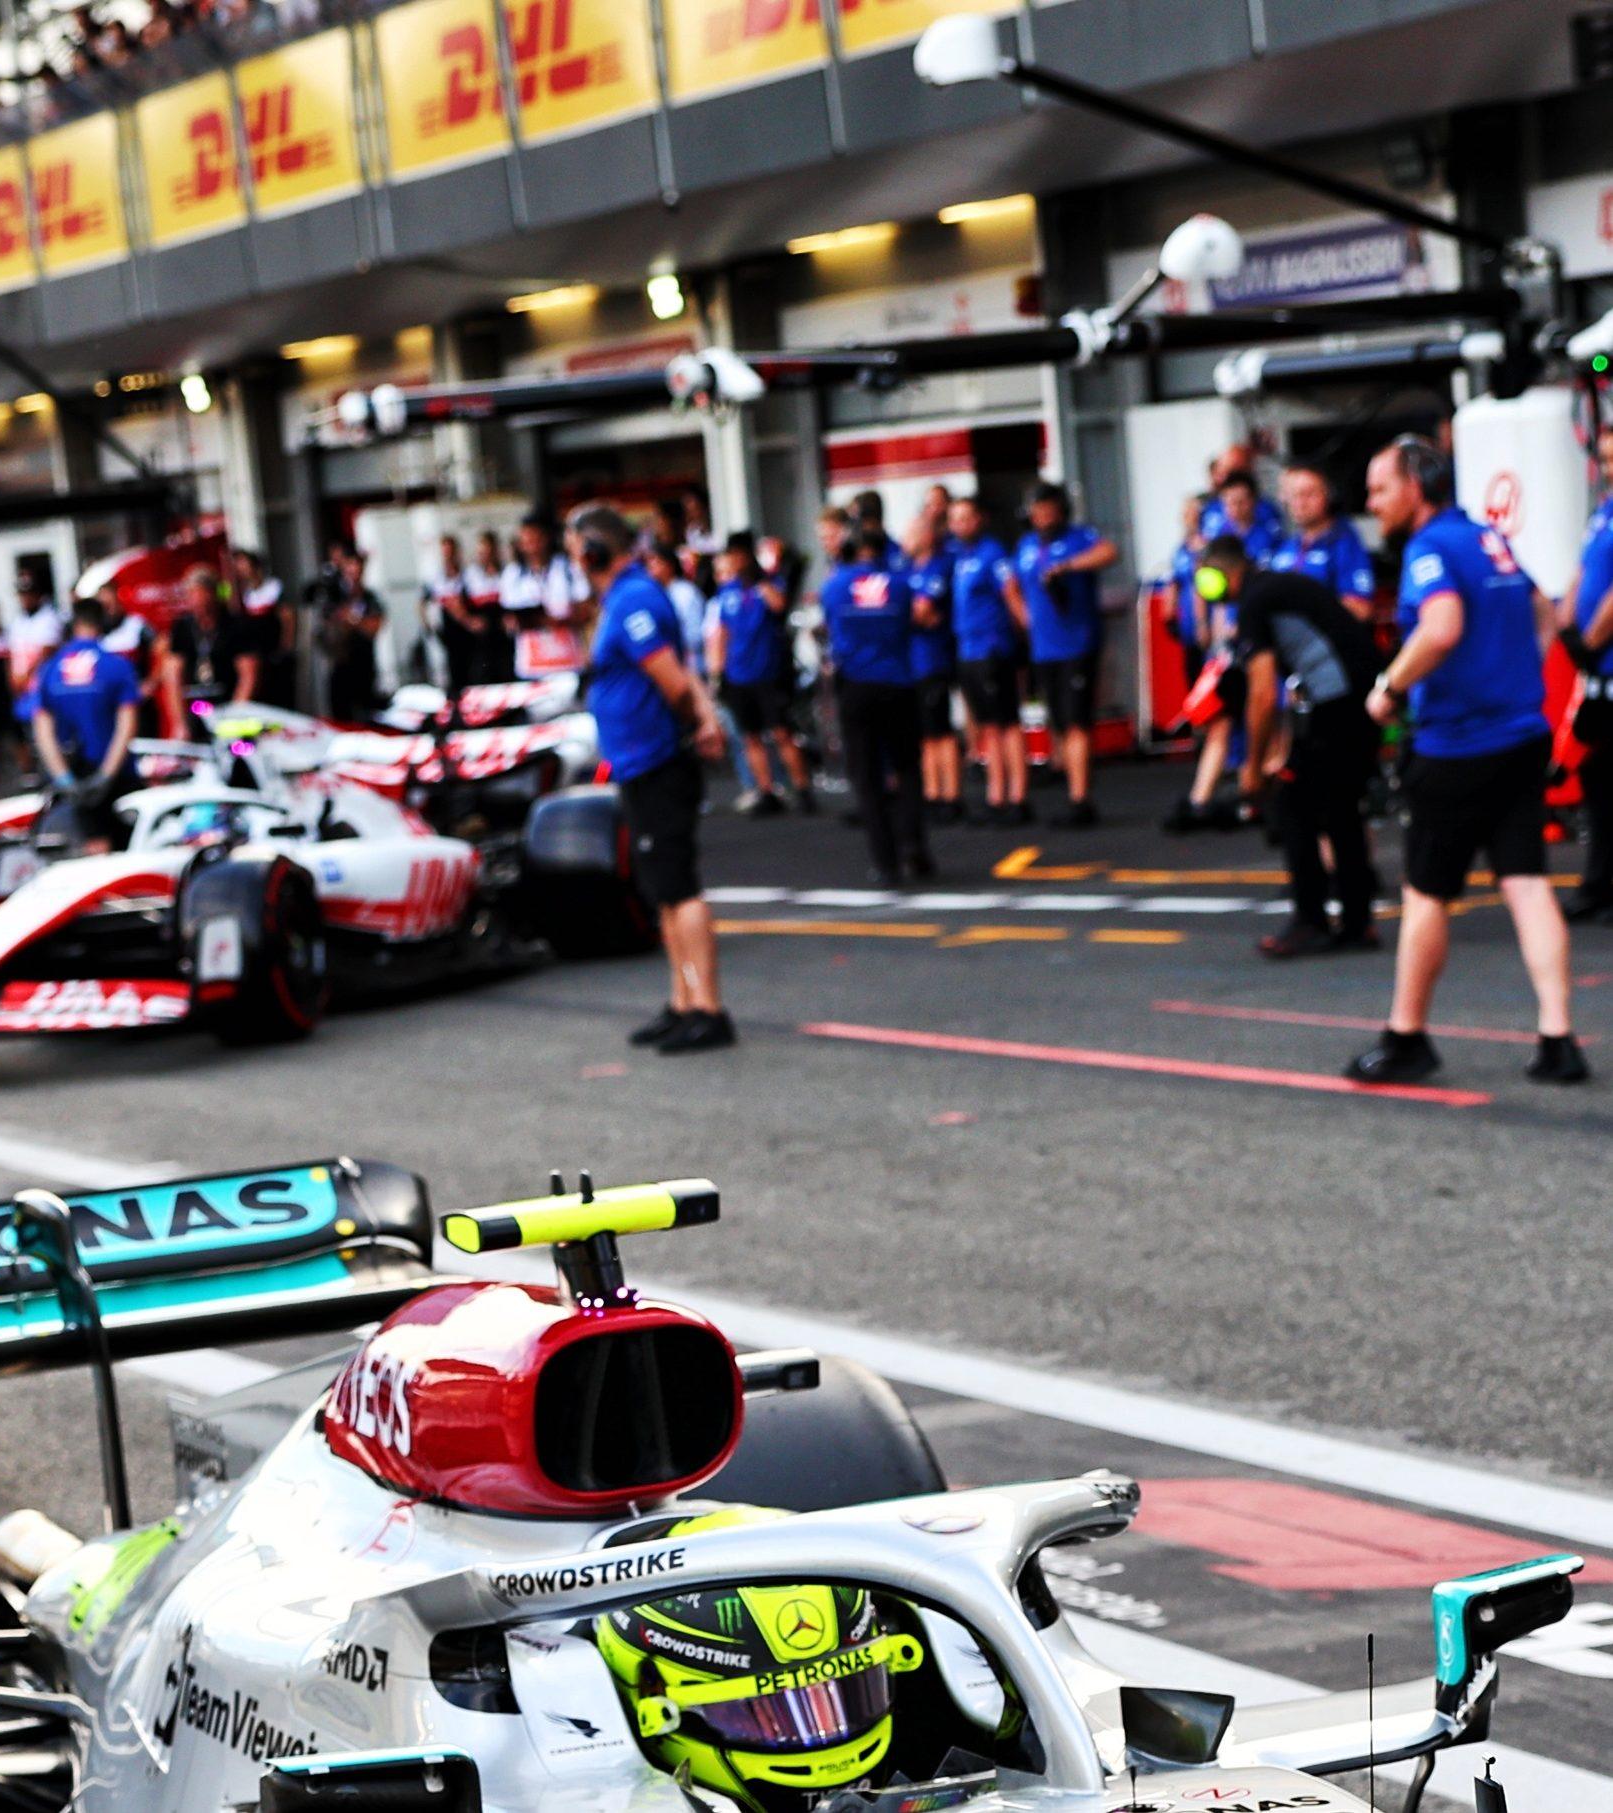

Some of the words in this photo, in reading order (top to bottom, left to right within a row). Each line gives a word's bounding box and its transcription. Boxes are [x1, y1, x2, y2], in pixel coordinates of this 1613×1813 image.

[494, 1547, 687, 1598] CROWDSTRIKE
[644, 1628, 752, 1669] CROWDSTRIKE
[755, 1646, 874, 1694] PETRONAS
